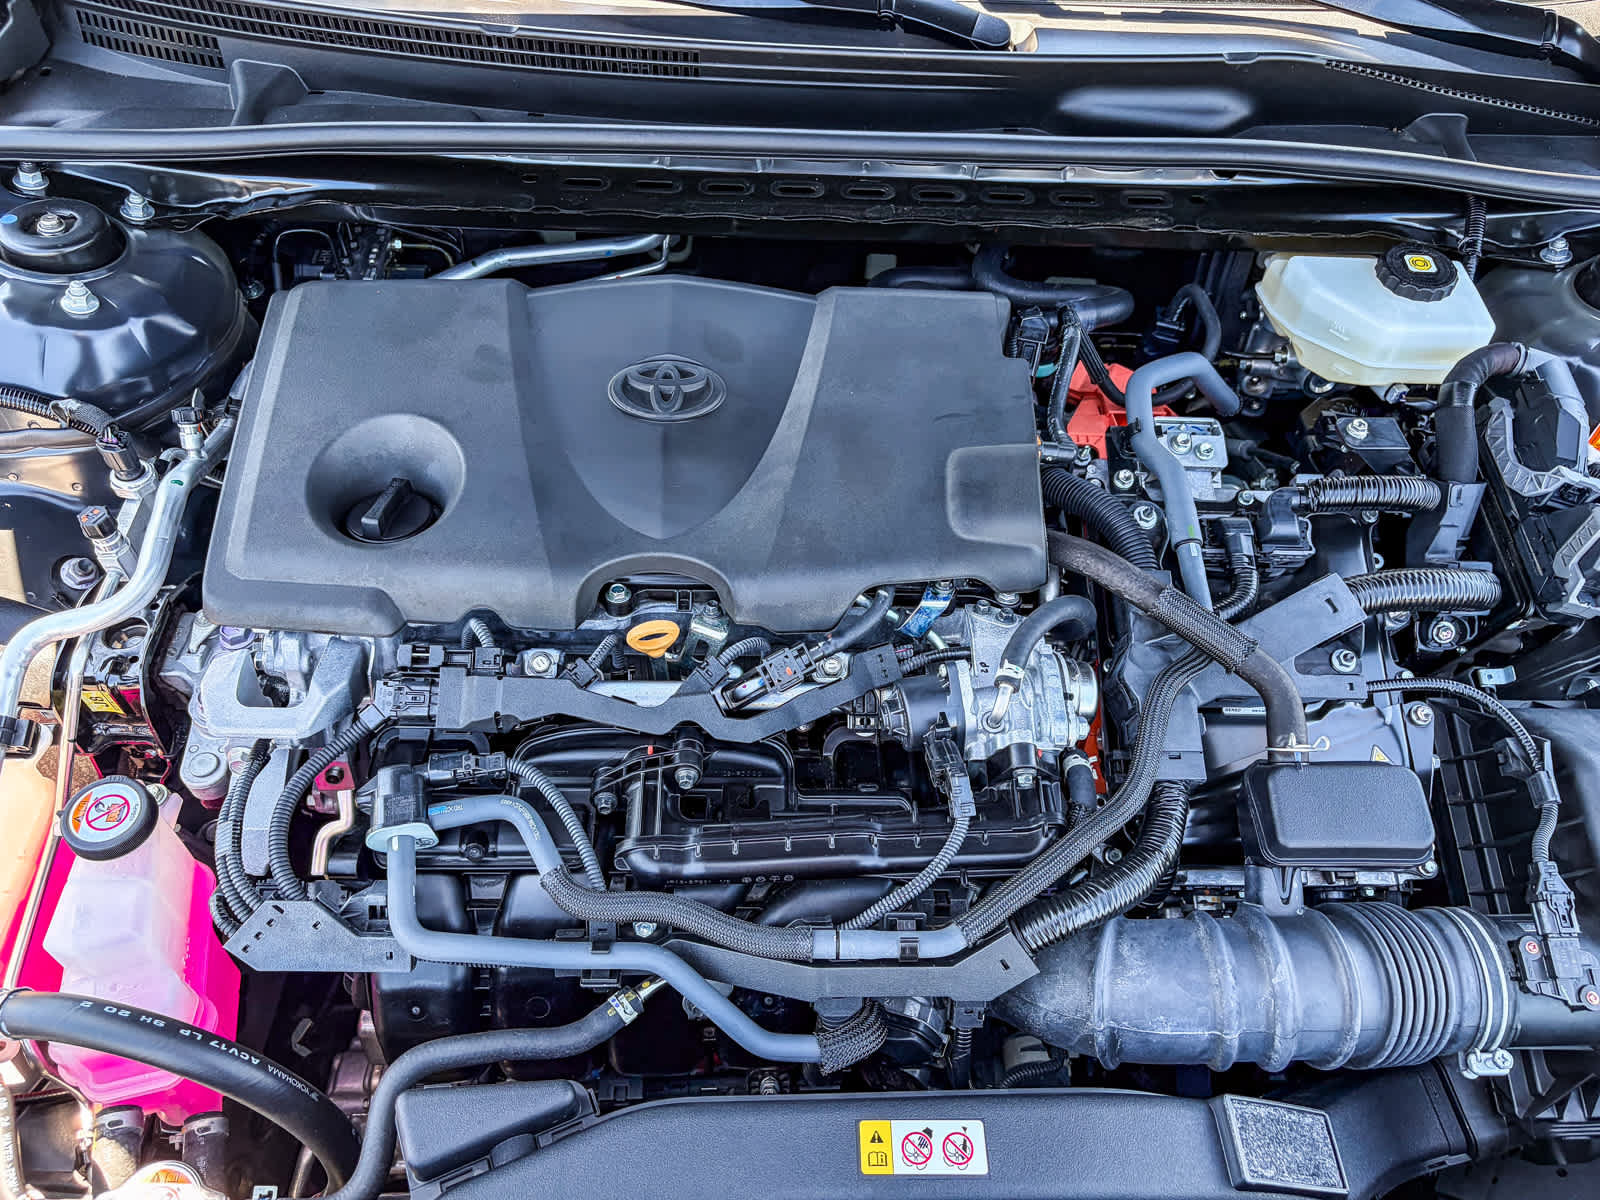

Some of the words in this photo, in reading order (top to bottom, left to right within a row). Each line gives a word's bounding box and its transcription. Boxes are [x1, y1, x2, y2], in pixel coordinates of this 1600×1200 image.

[79, 1000, 94, 1008] 2
[103, 1005, 132, 1017] 20
[179, 1028, 203, 1041] LP
[209, 1040, 260, 1065] ACV17
[267, 1064, 311, 1096] YOKOHAMA
